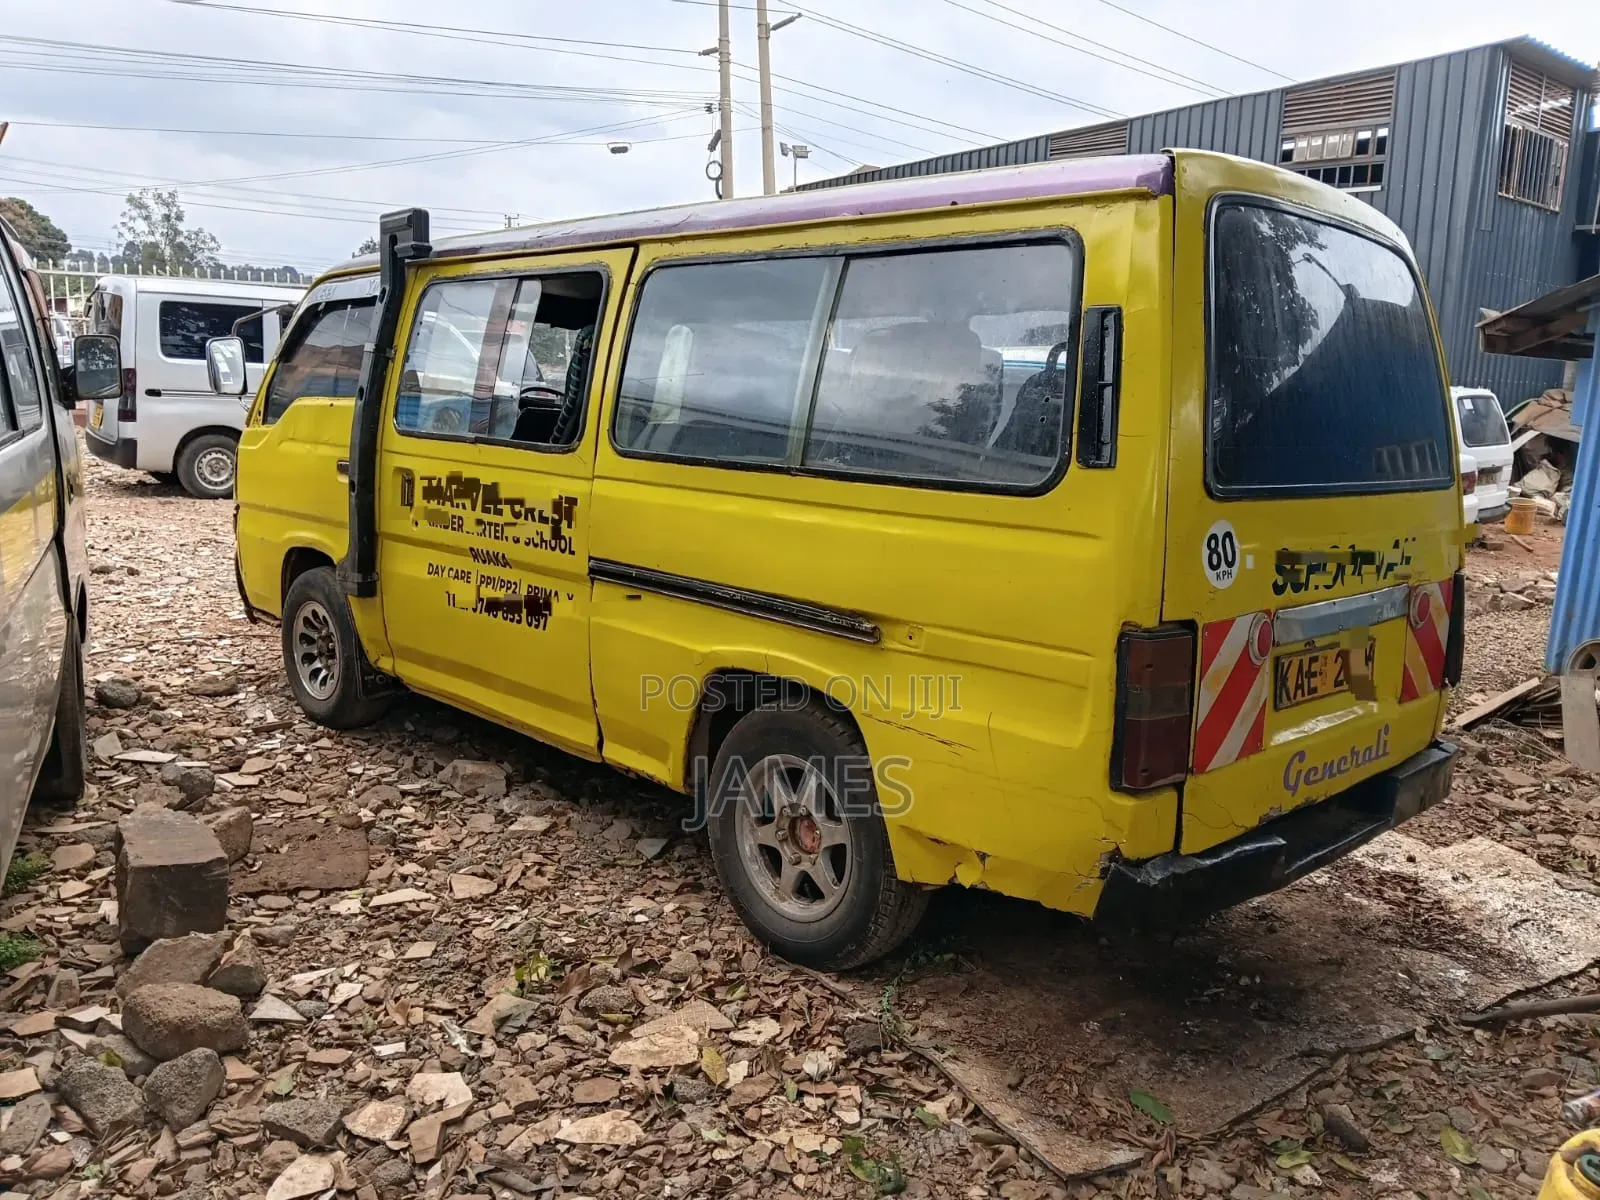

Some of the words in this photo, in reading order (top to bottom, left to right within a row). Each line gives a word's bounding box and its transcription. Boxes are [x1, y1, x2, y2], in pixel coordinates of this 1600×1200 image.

[421, 474, 504, 516] AVEL
[469, 547, 513, 570] RUAKA
[1207, 531, 1237, 571] 80
[427, 562, 447, 578] DAY
[447, 567, 472, 584] CARE
[526, 584, 575, 603] PRIMAY
[1216, 569, 1233, 581] KPH
[1279, 654, 1320, 704] KAE
[1283, 723, 1391, 795] Generali
